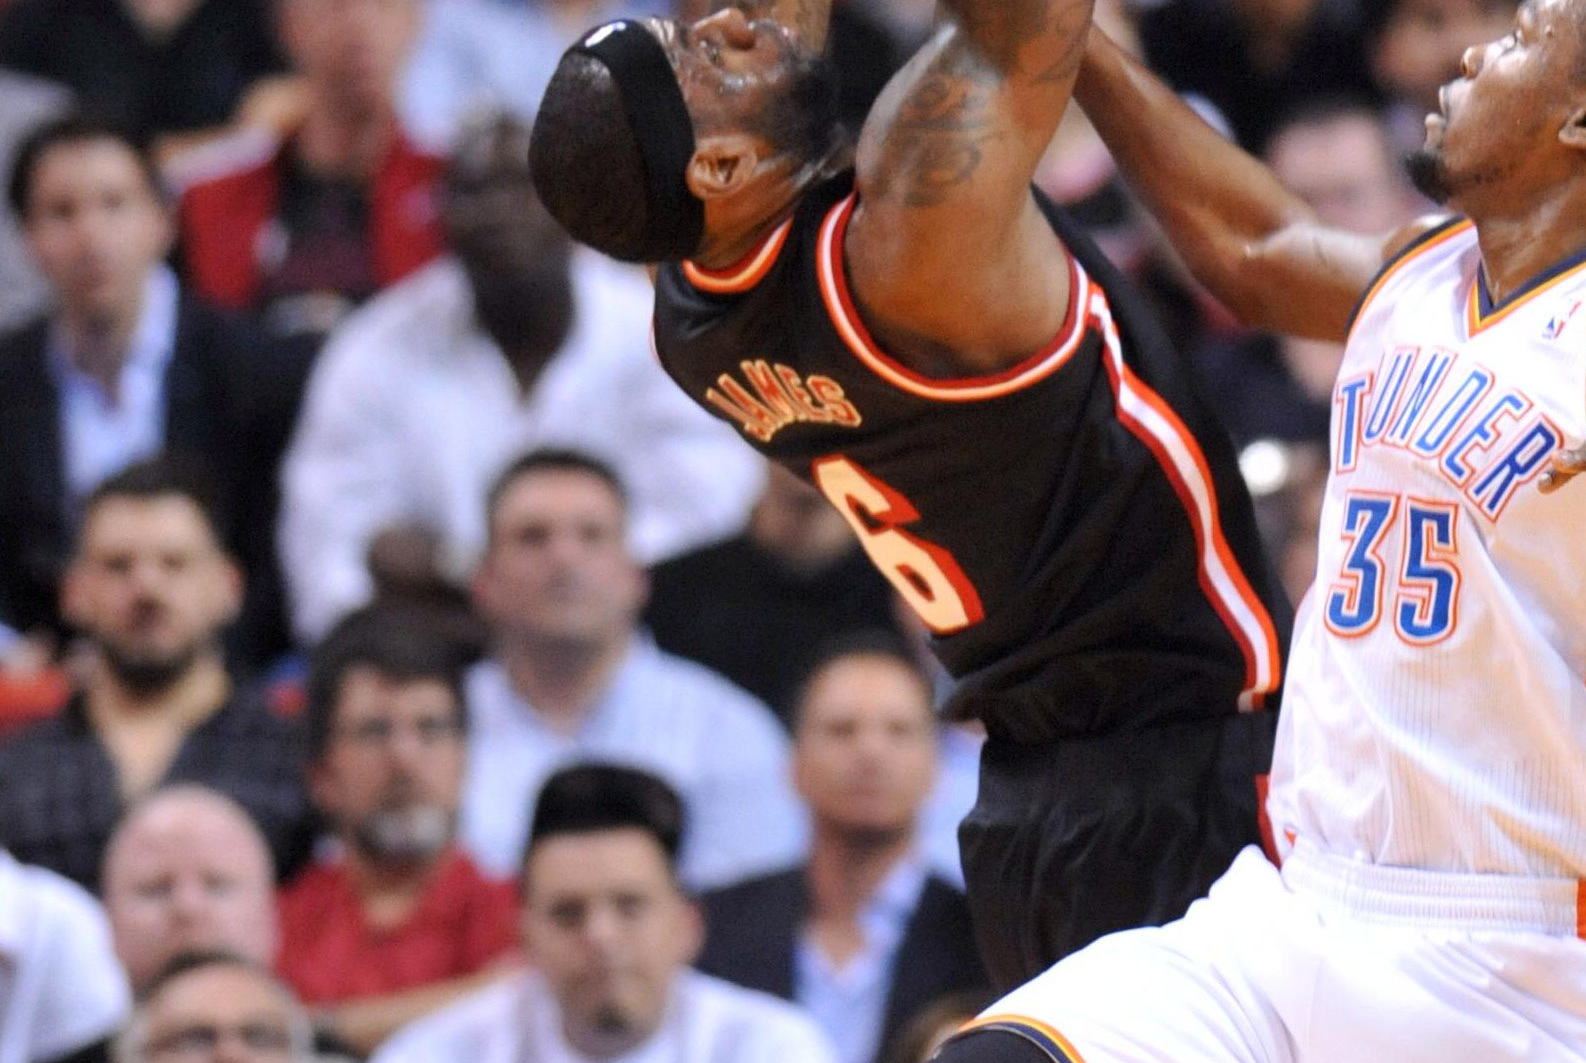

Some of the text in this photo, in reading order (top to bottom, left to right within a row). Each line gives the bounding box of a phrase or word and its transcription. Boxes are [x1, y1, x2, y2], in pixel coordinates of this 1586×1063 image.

[706, 360, 862, 441] JAMES
[812, 454, 985, 634] 6
[1324, 490, 1462, 647] 35
